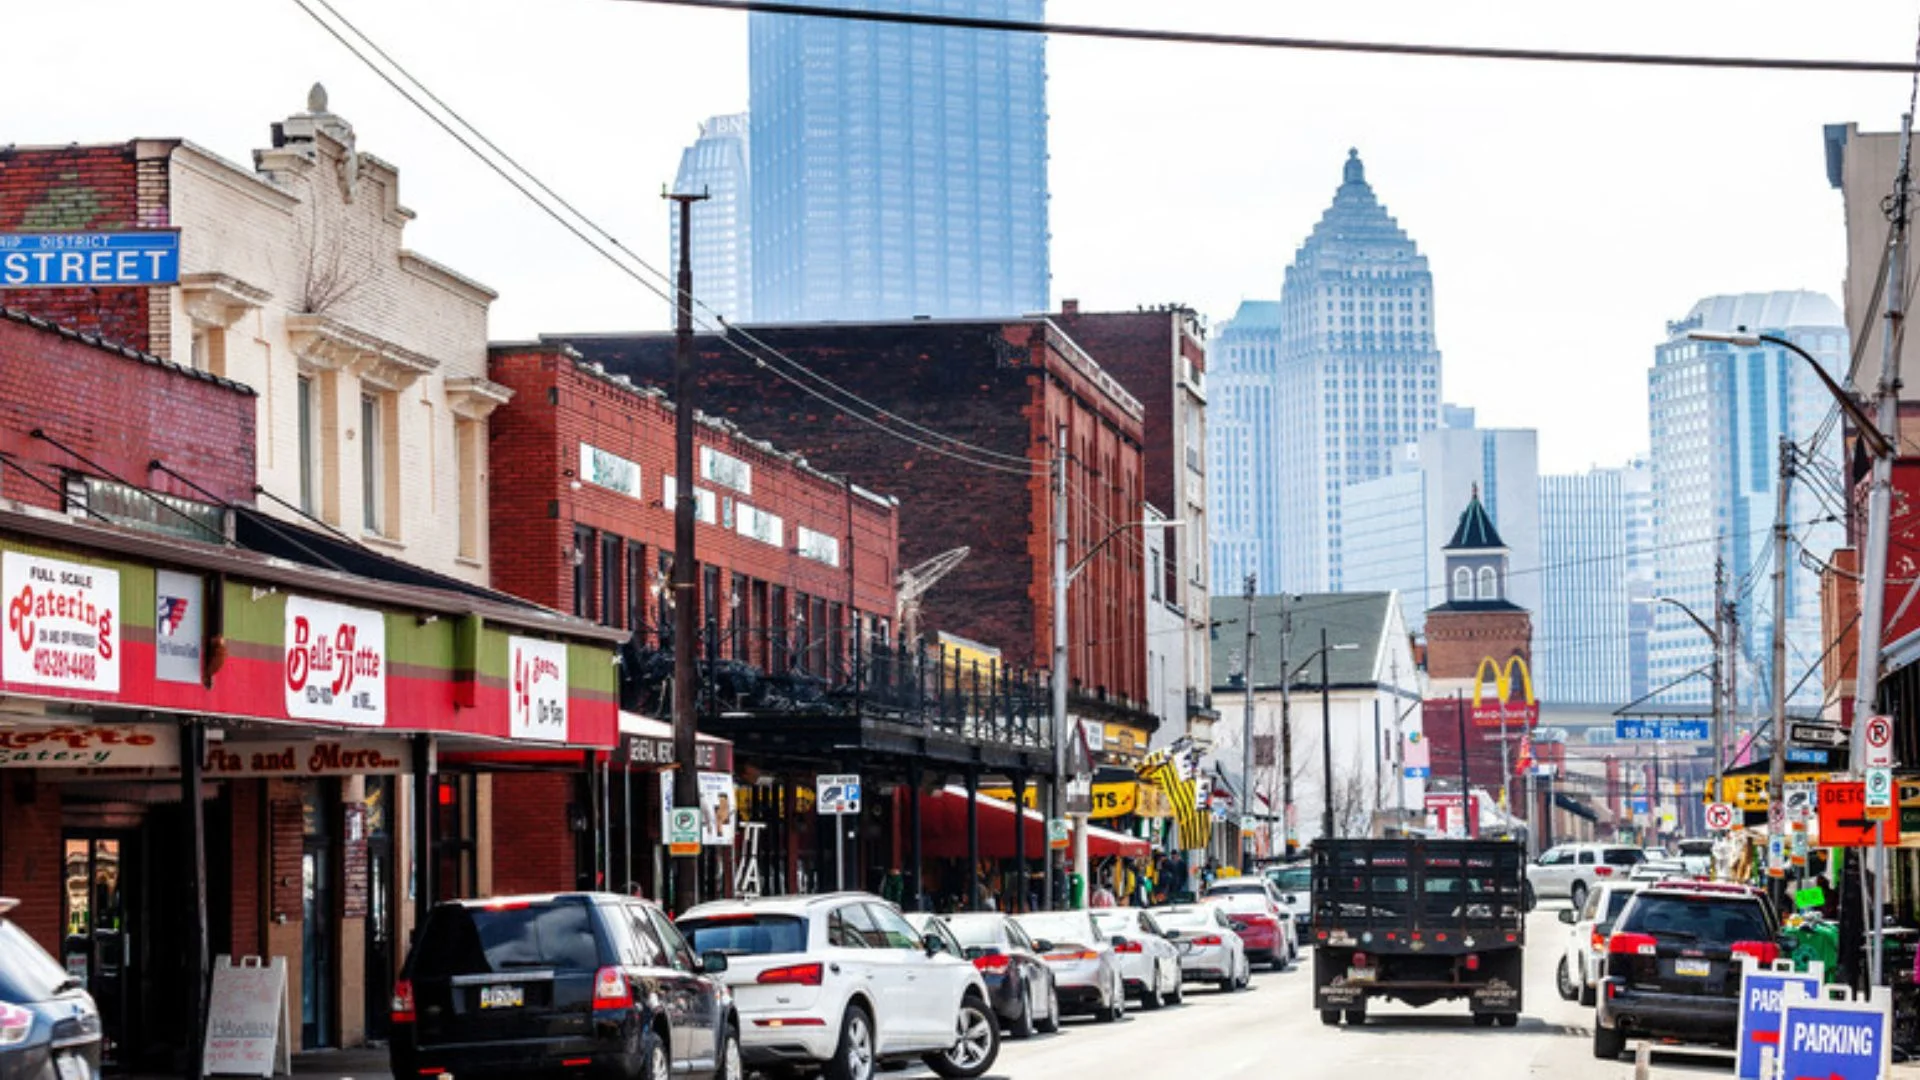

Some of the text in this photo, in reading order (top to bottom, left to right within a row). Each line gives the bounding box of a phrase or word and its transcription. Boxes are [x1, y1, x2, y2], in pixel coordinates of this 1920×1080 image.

[40, 235, 110, 249] DISTRICT
[4, 250, 168, 283] STREET
[30, 566, 92, 589] FULL SCALE
[10, 584, 112, 660] Catering
[287, 615, 380, 696] Bella Notte
[1660, 726, 1701, 738] Street
[251, 747, 296, 771] and
[308, 742, 399, 773] More...
[1091, 791, 1116, 809] TS
[1825, 789, 1865, 804] DETO
[1793, 1023, 1873, 1056] PARKING
